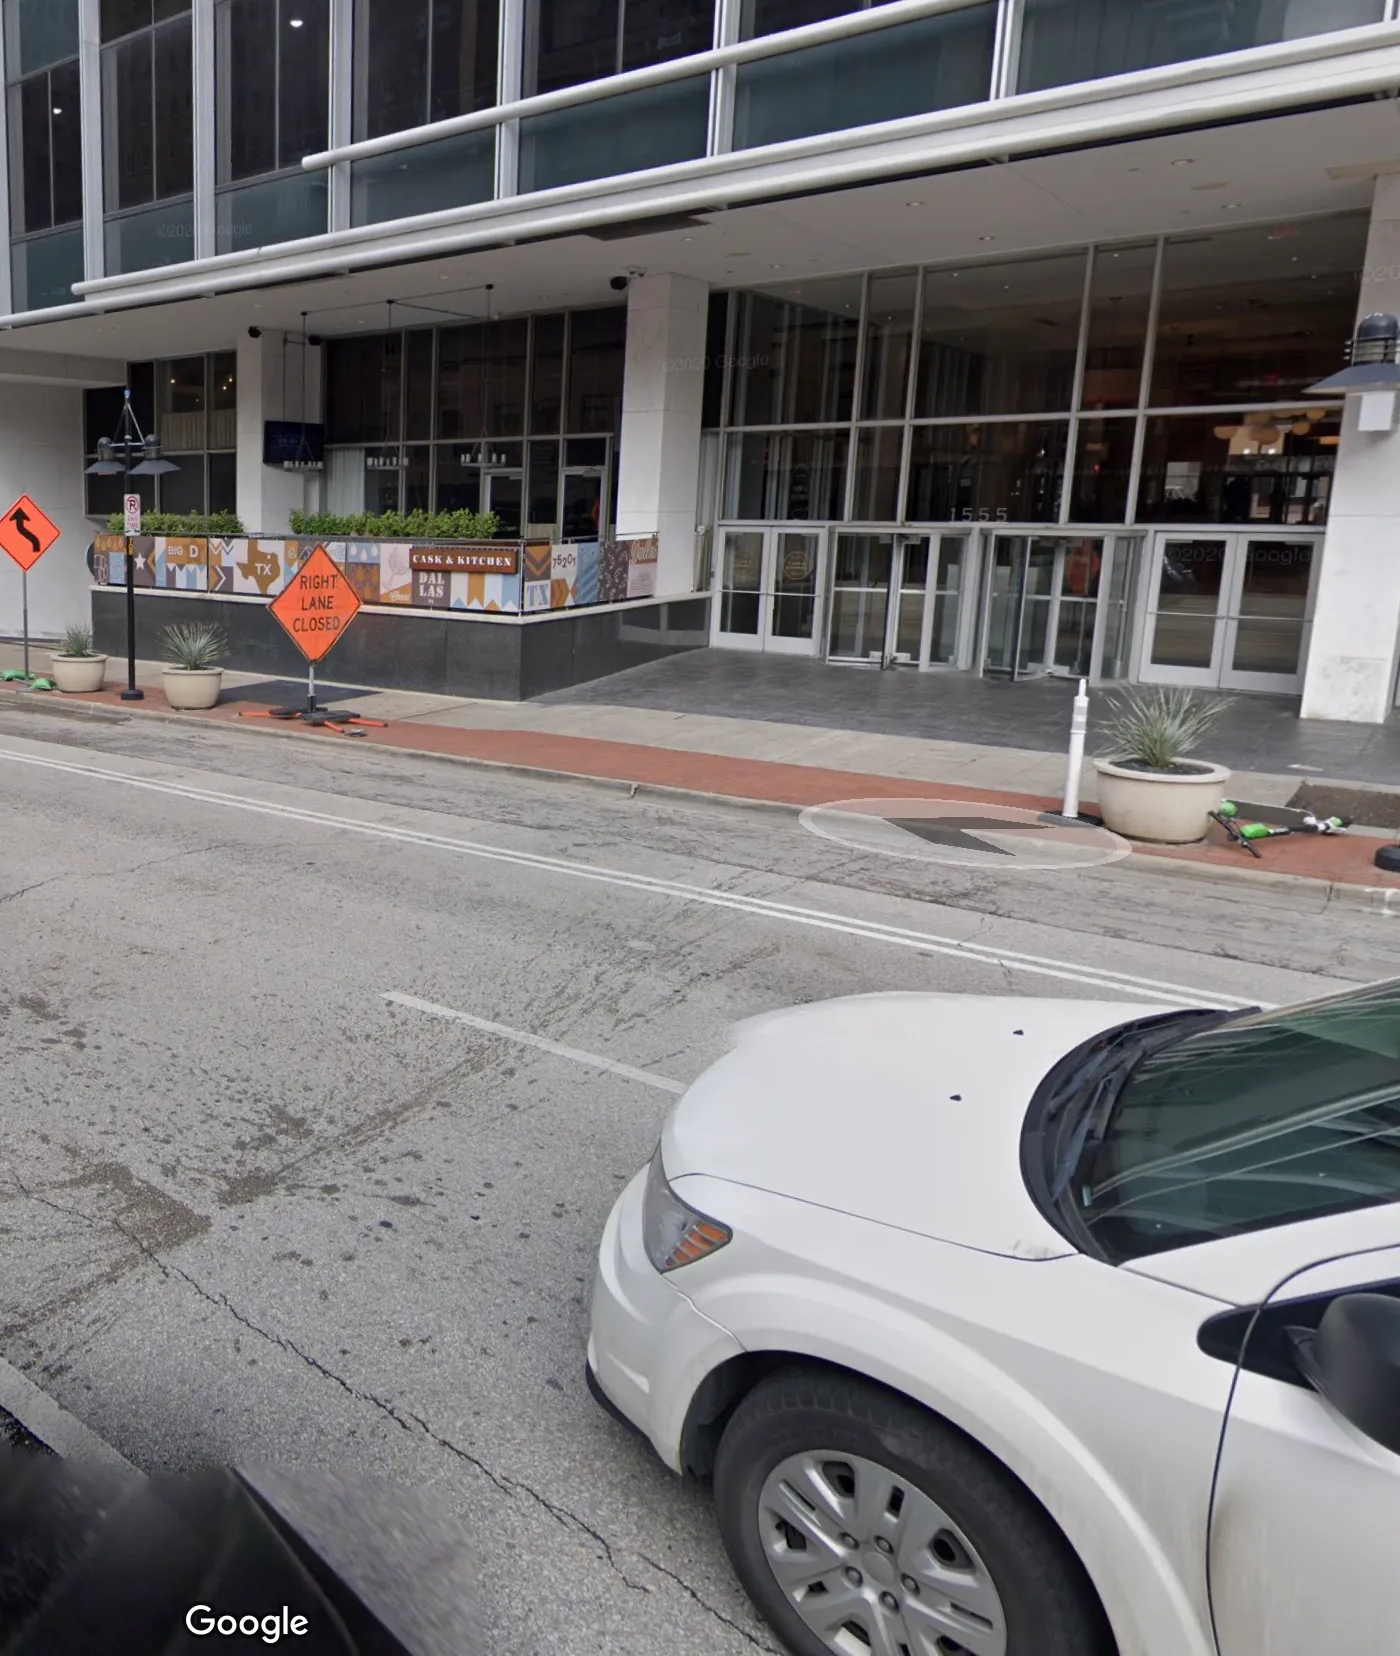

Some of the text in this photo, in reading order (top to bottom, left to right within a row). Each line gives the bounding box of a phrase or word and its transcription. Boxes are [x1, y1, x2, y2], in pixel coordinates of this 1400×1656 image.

[951, 507, 1008, 522] 1555
[167, 545, 199, 558] BIG D
[412, 554, 512, 567] CASK & KITCHEN
[552, 553, 577, 569] 75201
[255, 563, 272, 575] TX
[299, 574, 338, 590] RIGHT
[418, 571, 446, 585] DAL
[419, 584, 444, 598] LAS
[527, 584, 549, 607] TX
[301, 596, 334, 611] LANE
[292, 616, 340, 633] CLOSED
